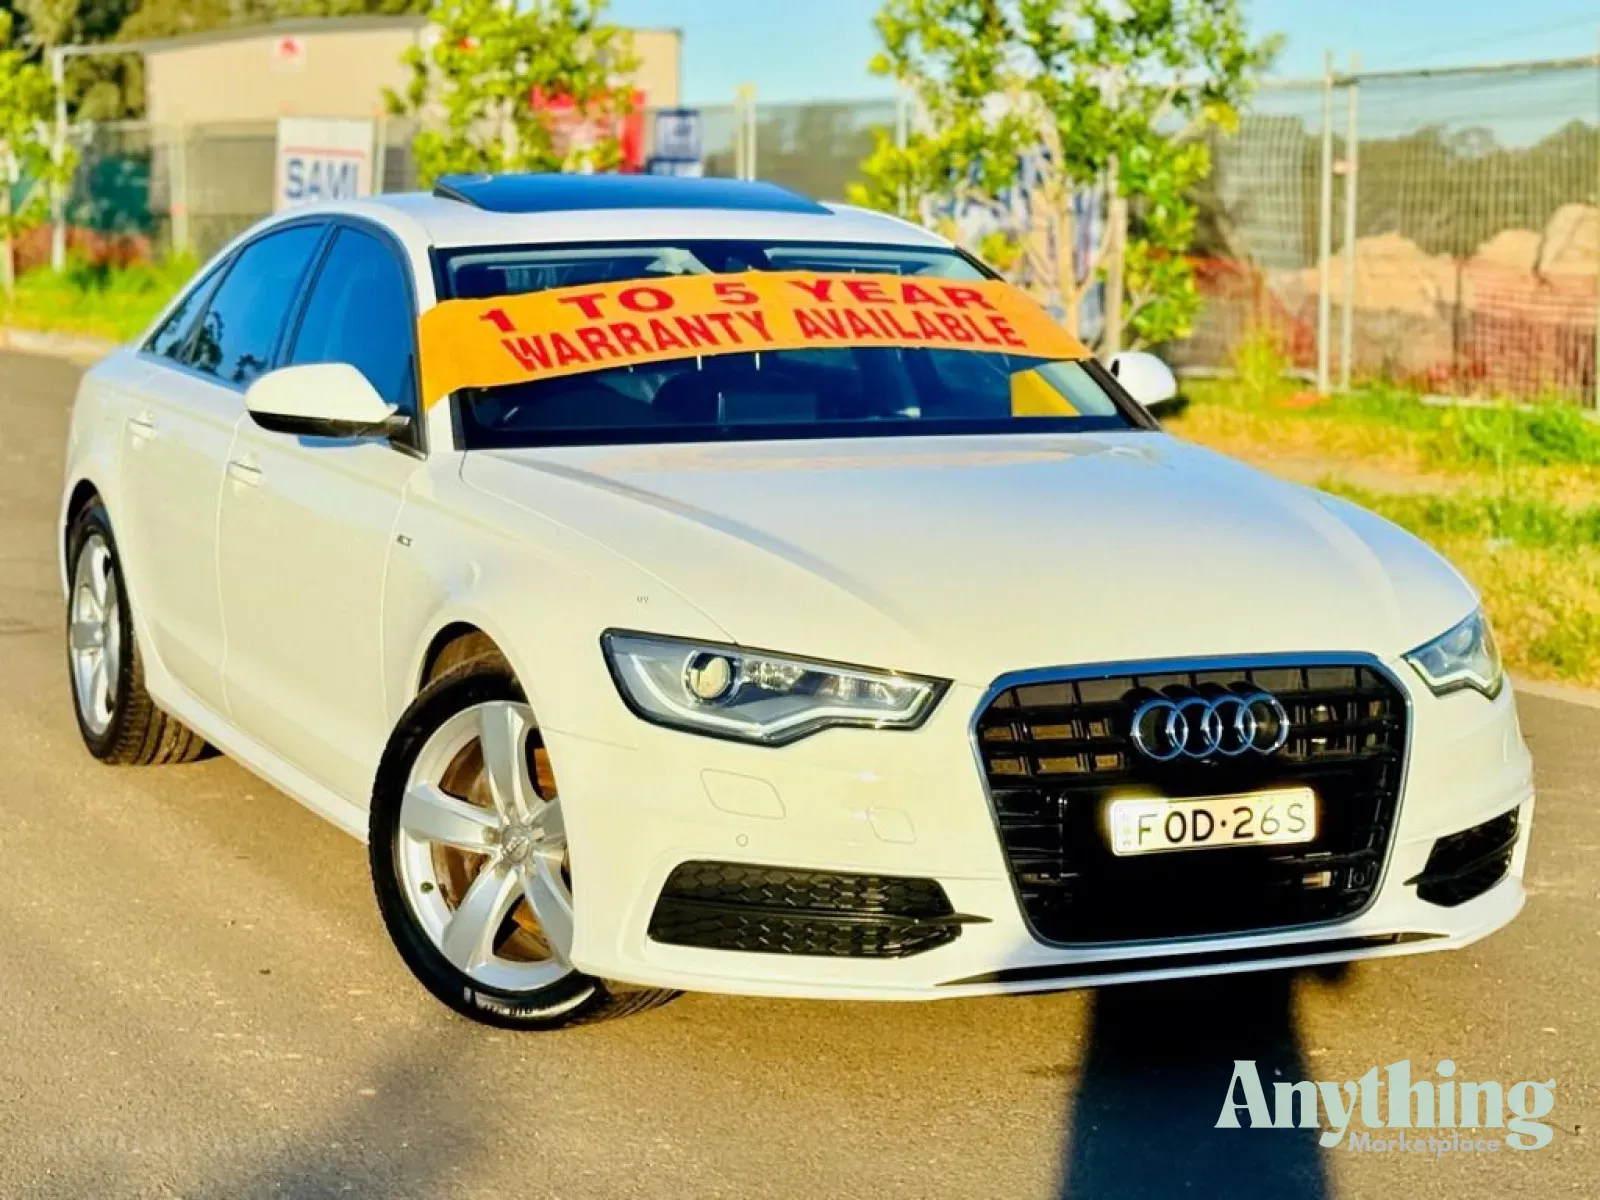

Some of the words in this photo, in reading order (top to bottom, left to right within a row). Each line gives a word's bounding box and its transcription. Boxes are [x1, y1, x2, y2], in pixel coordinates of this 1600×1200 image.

[480, 308, 516, 333] 1
[558, 286, 675, 320] TO
[713, 282, 759, 305] 5
[790, 279, 996, 310] YEAR
[501, 311, 768, 373] WARRANTY
[798, 308, 1026, 348] AVAILABLE
